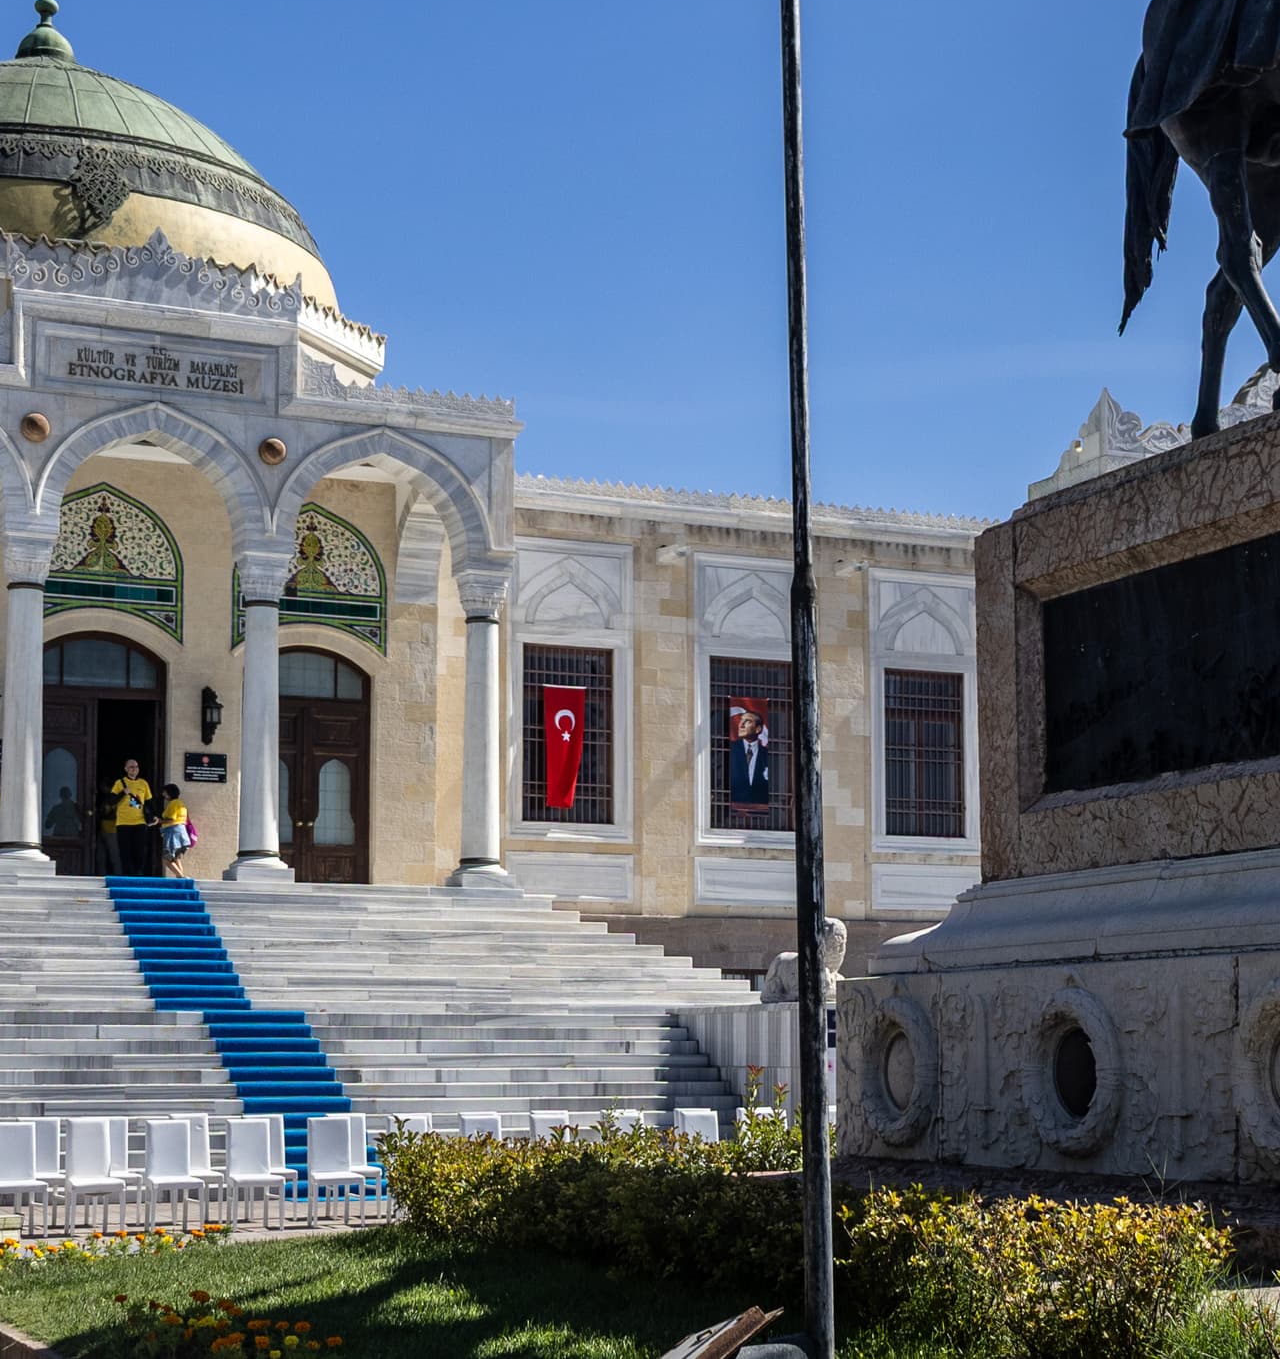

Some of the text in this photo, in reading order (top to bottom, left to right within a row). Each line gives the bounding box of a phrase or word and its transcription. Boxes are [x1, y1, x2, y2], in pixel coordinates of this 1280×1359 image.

[69, 363, 244, 394] ETNOGRAFYA MÜZESİ
[76, 346, 238, 379] KÜLTÜR VE TURİZM BAKANLIĞI
